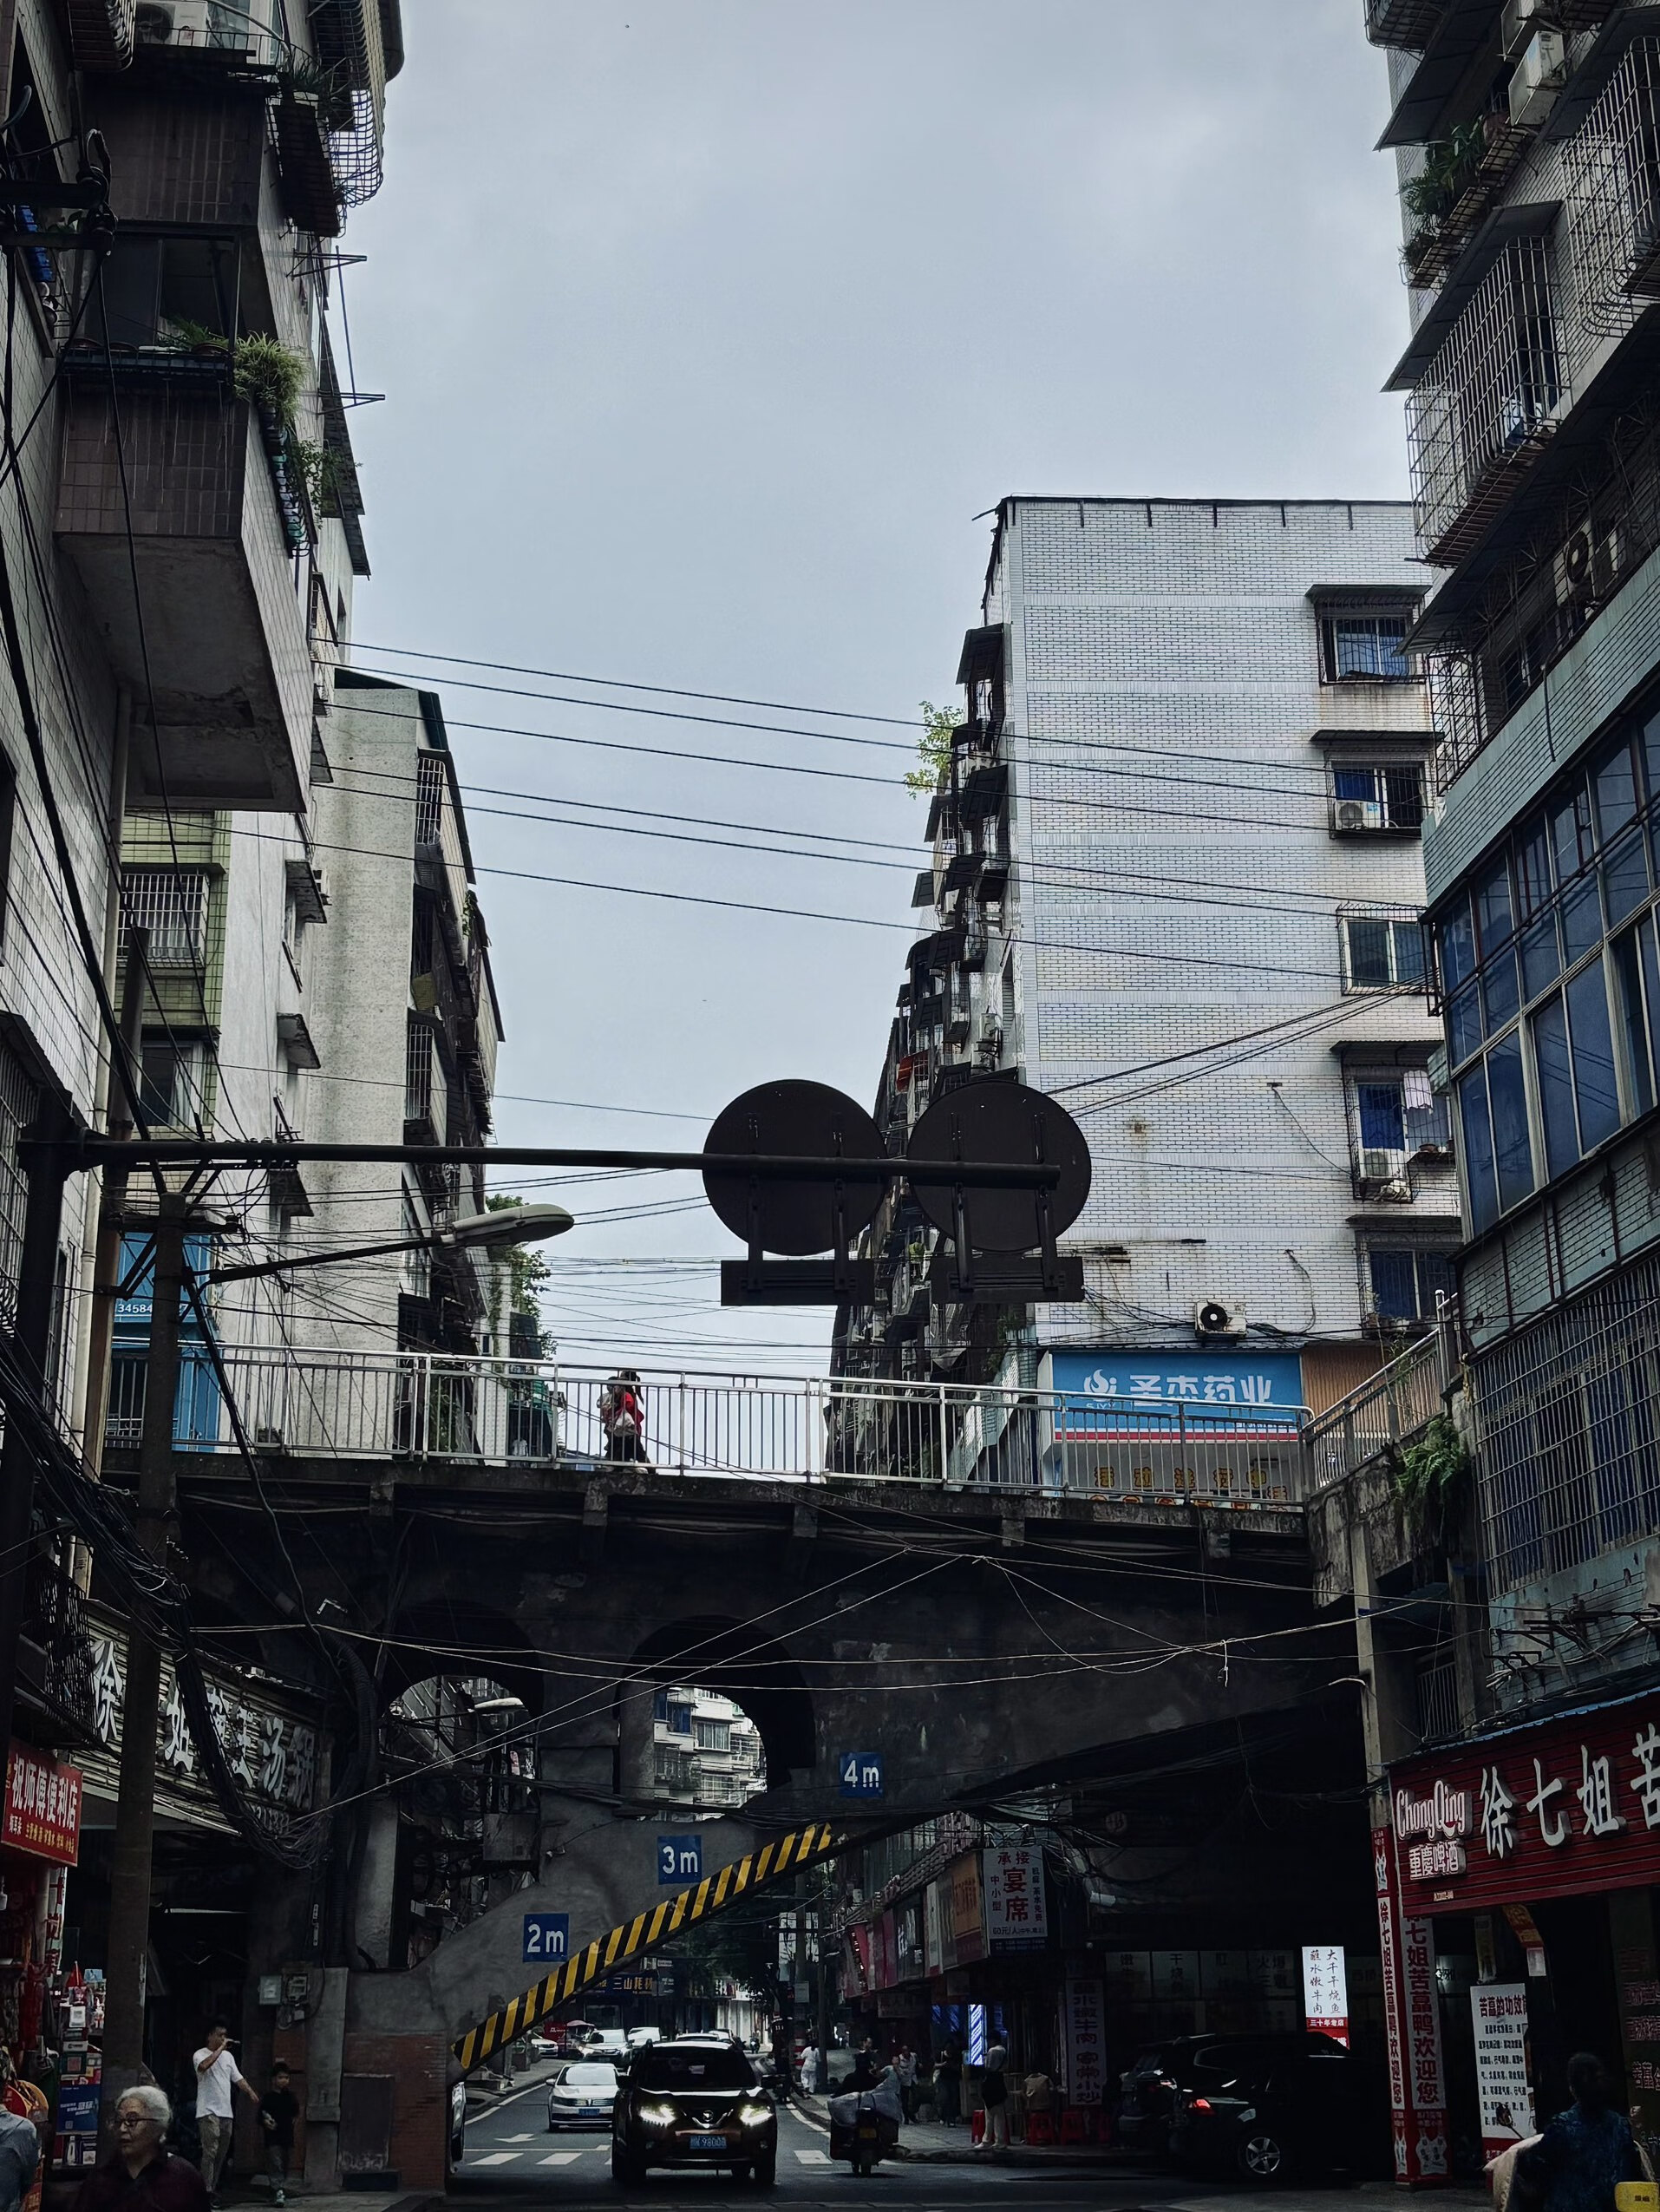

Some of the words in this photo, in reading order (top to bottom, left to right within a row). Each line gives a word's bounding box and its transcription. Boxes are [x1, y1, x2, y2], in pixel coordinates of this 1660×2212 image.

[1129, 1375, 1272, 1406] 圣杰药业
[844, 1759, 880, 1789] 4m
[1396, 1780, 1466, 1841] ChongQing
[662, 1845, 699, 1874] 3m
[997, 1851, 1030, 1866] 承接
[990, 1875, 1002, 1911] 中小型
[1003, 1867, 1029, 1921] 宴席
[526, 1924, 564, 1953] 2m
